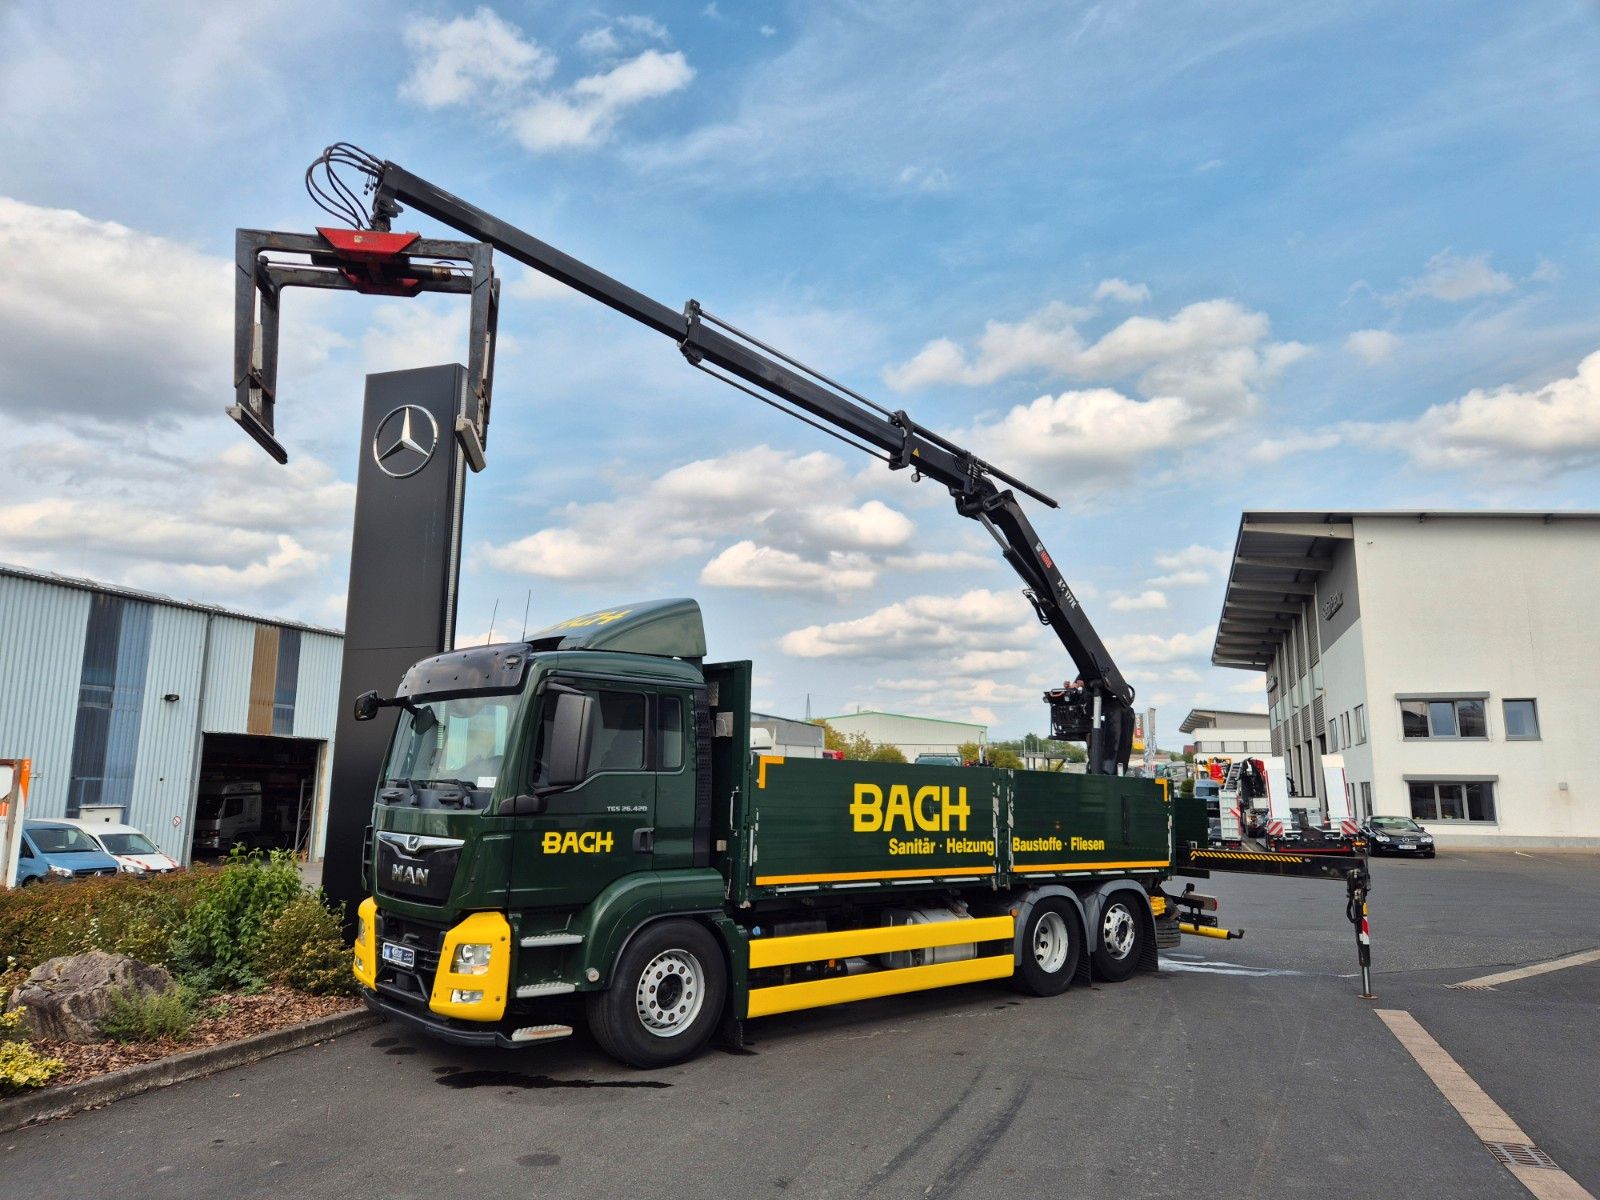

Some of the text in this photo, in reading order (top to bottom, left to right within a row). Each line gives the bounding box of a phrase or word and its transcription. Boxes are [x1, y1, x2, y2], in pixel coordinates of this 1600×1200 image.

[849, 783, 970, 832] BACH
[541, 831, 614, 854] BACH
[889, 836, 1105, 856] Sanitär Heizung Baustoffe Fliesen
[391, 863, 429, 887] MAN
